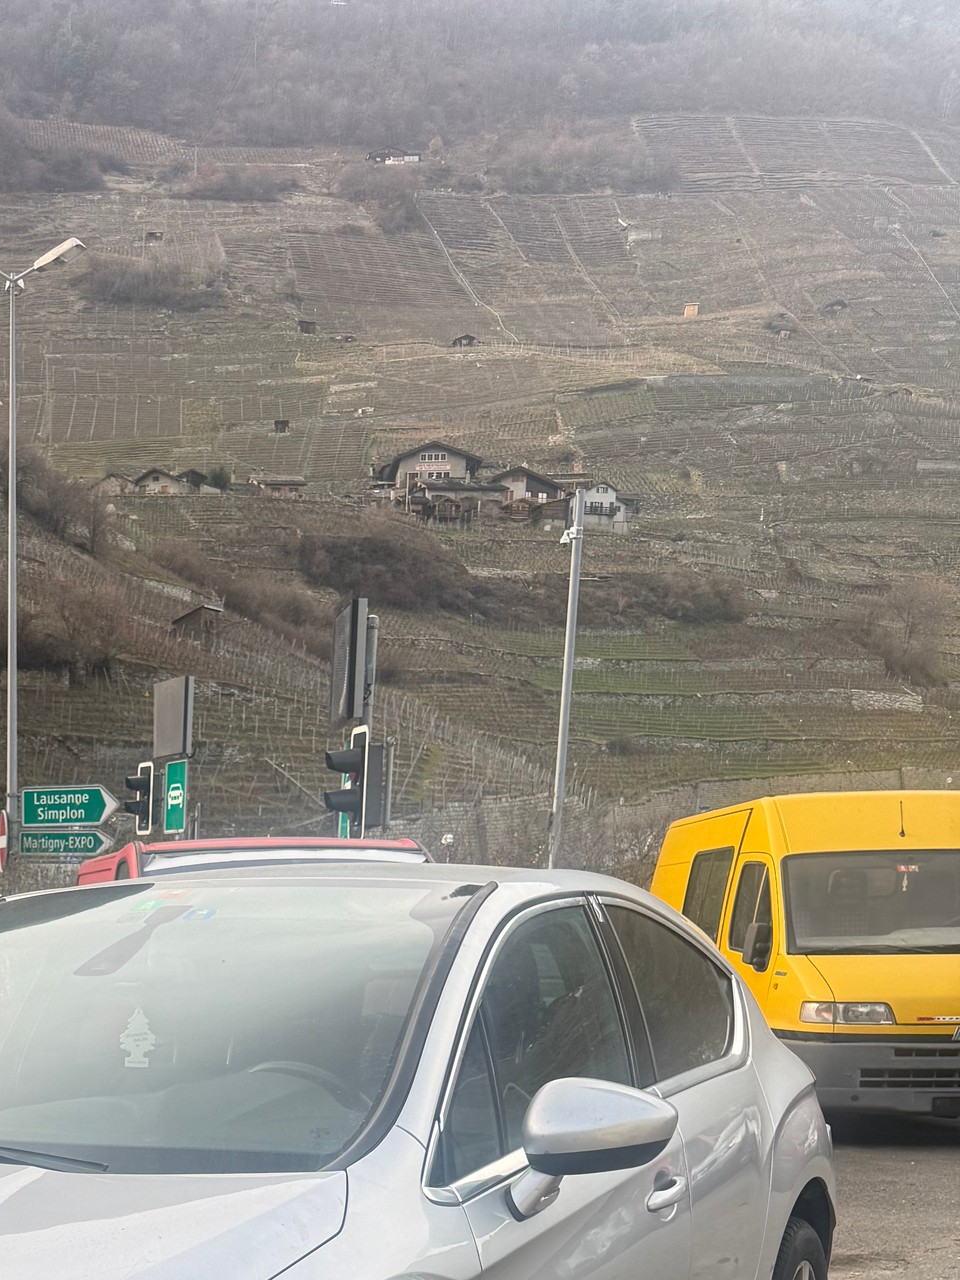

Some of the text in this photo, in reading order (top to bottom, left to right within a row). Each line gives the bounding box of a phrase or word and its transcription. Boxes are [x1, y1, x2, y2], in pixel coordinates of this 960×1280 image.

[33, 792, 89, 805] Lausanne
[37, 806, 85, 822] Simplon
[23, 836, 94, 852] Martigny-EXPO
